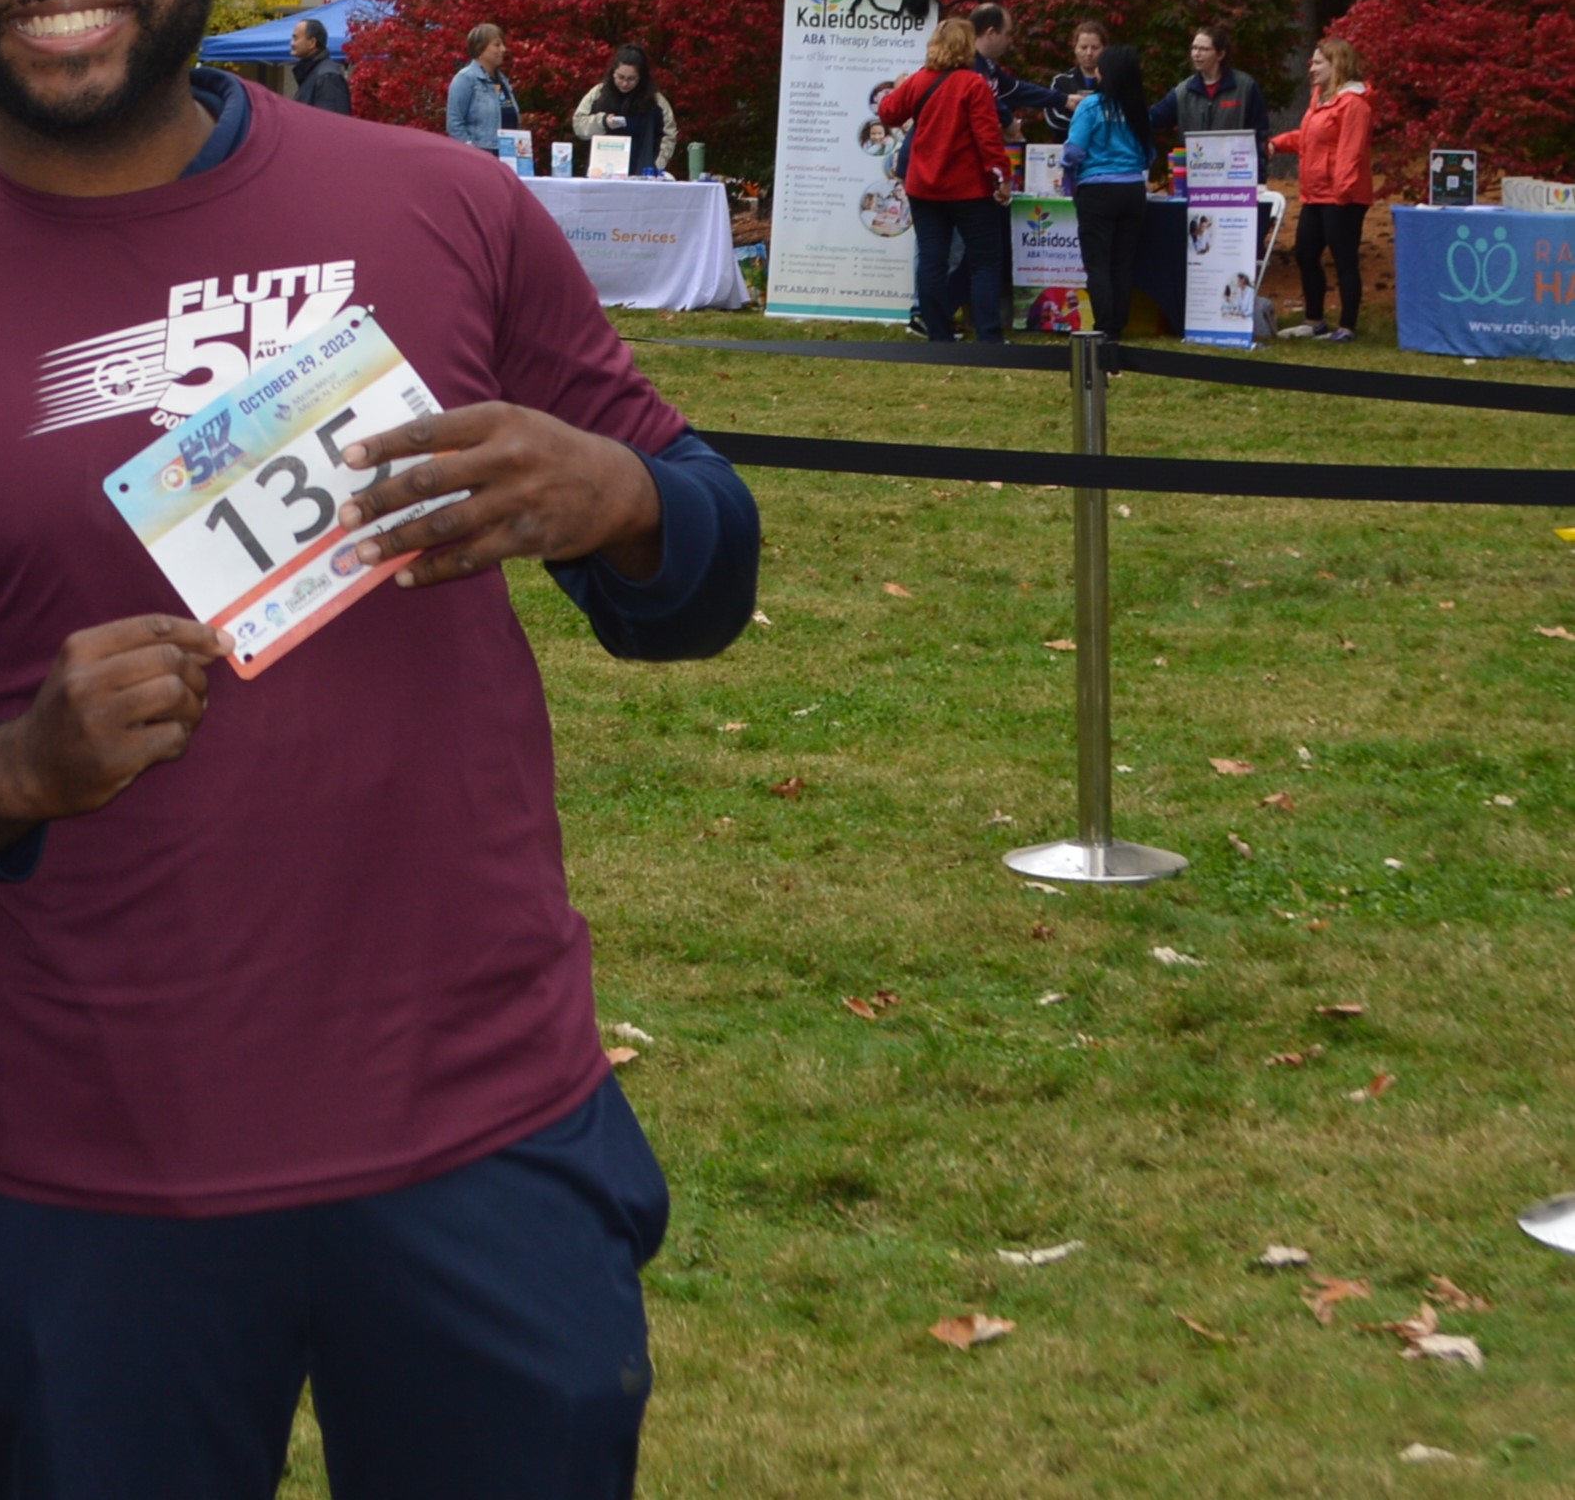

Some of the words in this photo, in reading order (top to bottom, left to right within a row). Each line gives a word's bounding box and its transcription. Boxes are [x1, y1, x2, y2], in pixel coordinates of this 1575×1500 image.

[796, 6, 925, 35] Kaleidoscope
[802, 33, 826, 45] ABA
[829, 34, 869, 49] Therapy
[872, 36, 916, 48] Services
[566, 227, 606, 241] utism
[611, 228, 677, 244] Services
[1021, 232, 1079, 248] Kaleidosc
[168, 259, 356, 318] FLUTIE
[1469, 319, 1575, 340] www.raisingh
[156, 290, 355, 414] 5K
[254, 344, 293, 360] AUT
[238, 369, 299, 416] OCTOBER
[295, 354, 324, 377] 29,
[318, 328, 357, 361] 2023
[150, 409, 188, 431] DO
[179, 408, 229, 452] FLUTIE
[183, 416, 245, 485] 5K
[204, 407, 393, 574] 135
